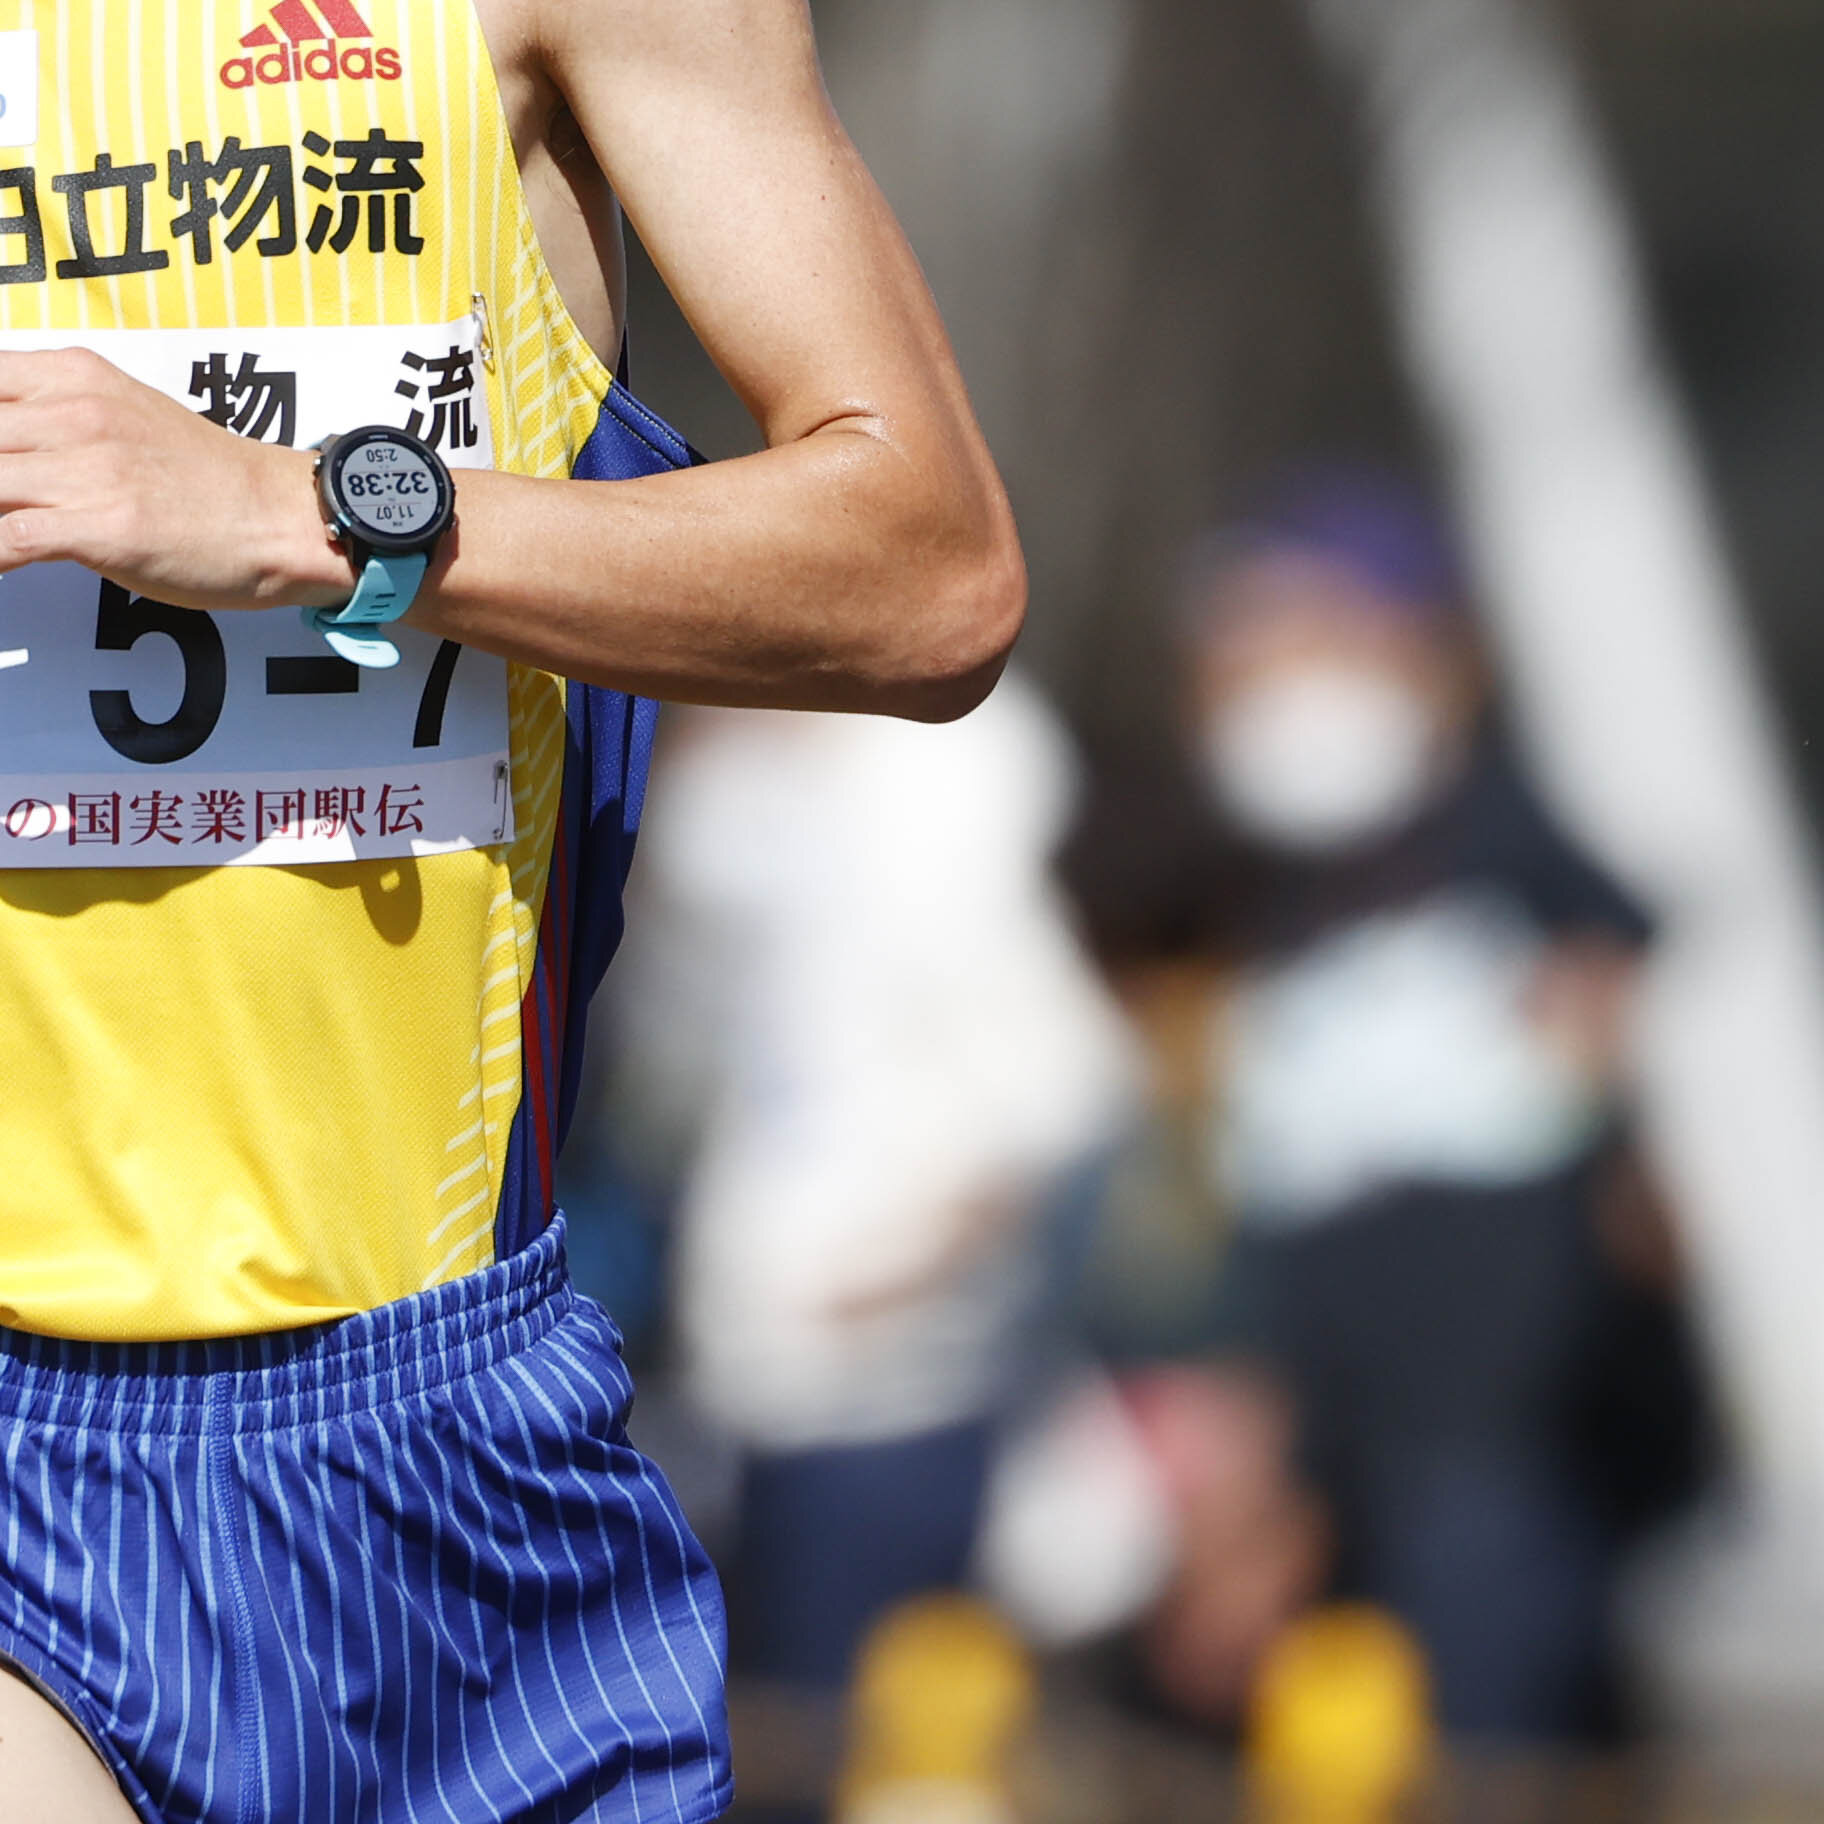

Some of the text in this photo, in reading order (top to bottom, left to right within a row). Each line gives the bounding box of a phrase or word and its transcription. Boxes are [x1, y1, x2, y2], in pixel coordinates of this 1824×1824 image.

[219, 37, 403, 90] adidas
[366, 448, 398, 463] 2:50
[347, 471, 430, 497] 32:38
